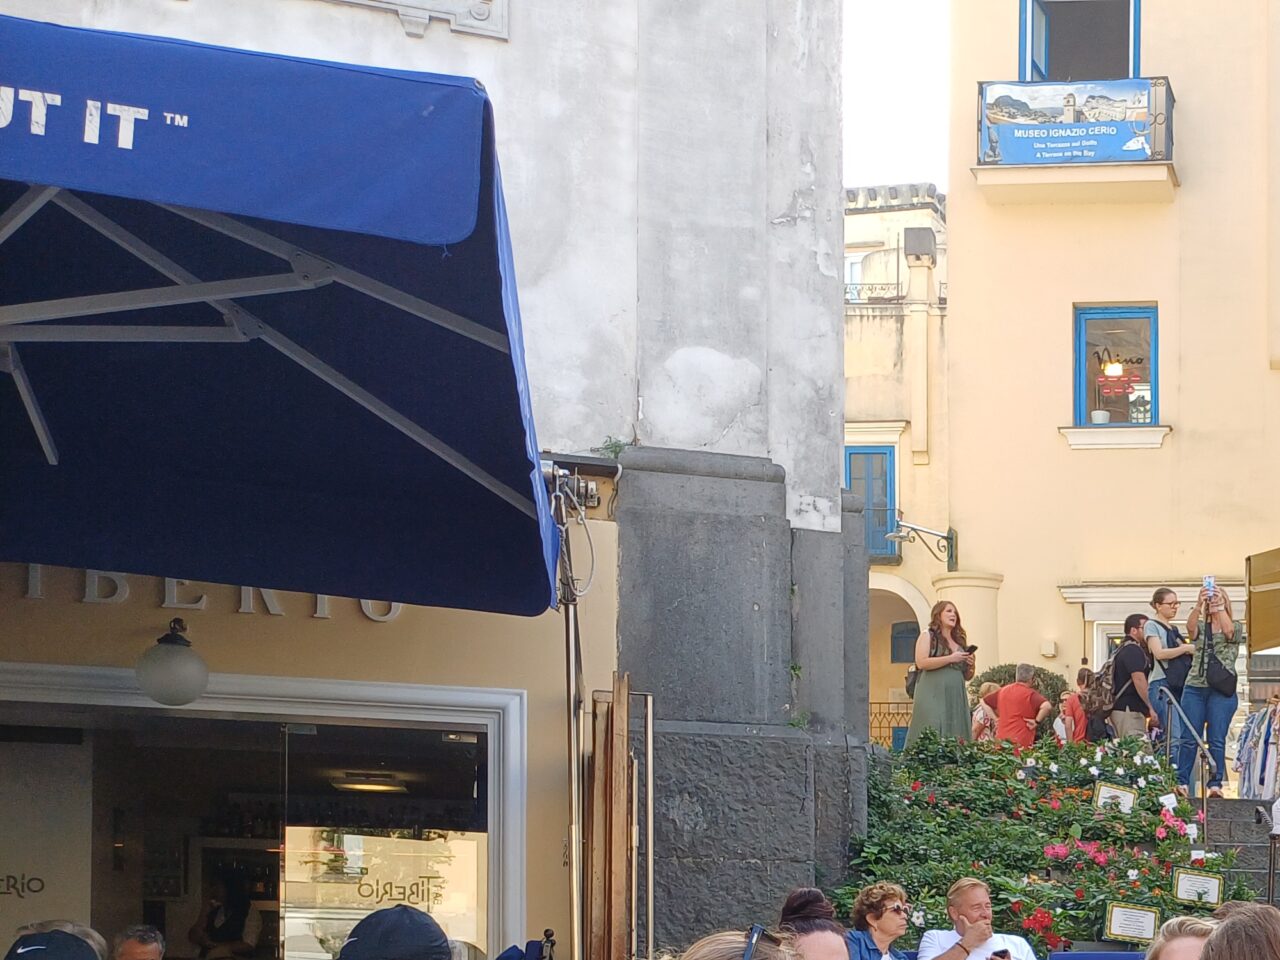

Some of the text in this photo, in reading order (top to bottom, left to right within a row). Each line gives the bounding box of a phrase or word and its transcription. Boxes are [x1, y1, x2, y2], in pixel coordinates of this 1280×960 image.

[83, 99, 149, 150] IT
[1014, 125, 1117, 138] MUSEO IGNAZIO CERIO
[1093, 345, 1144, 371] Nino
